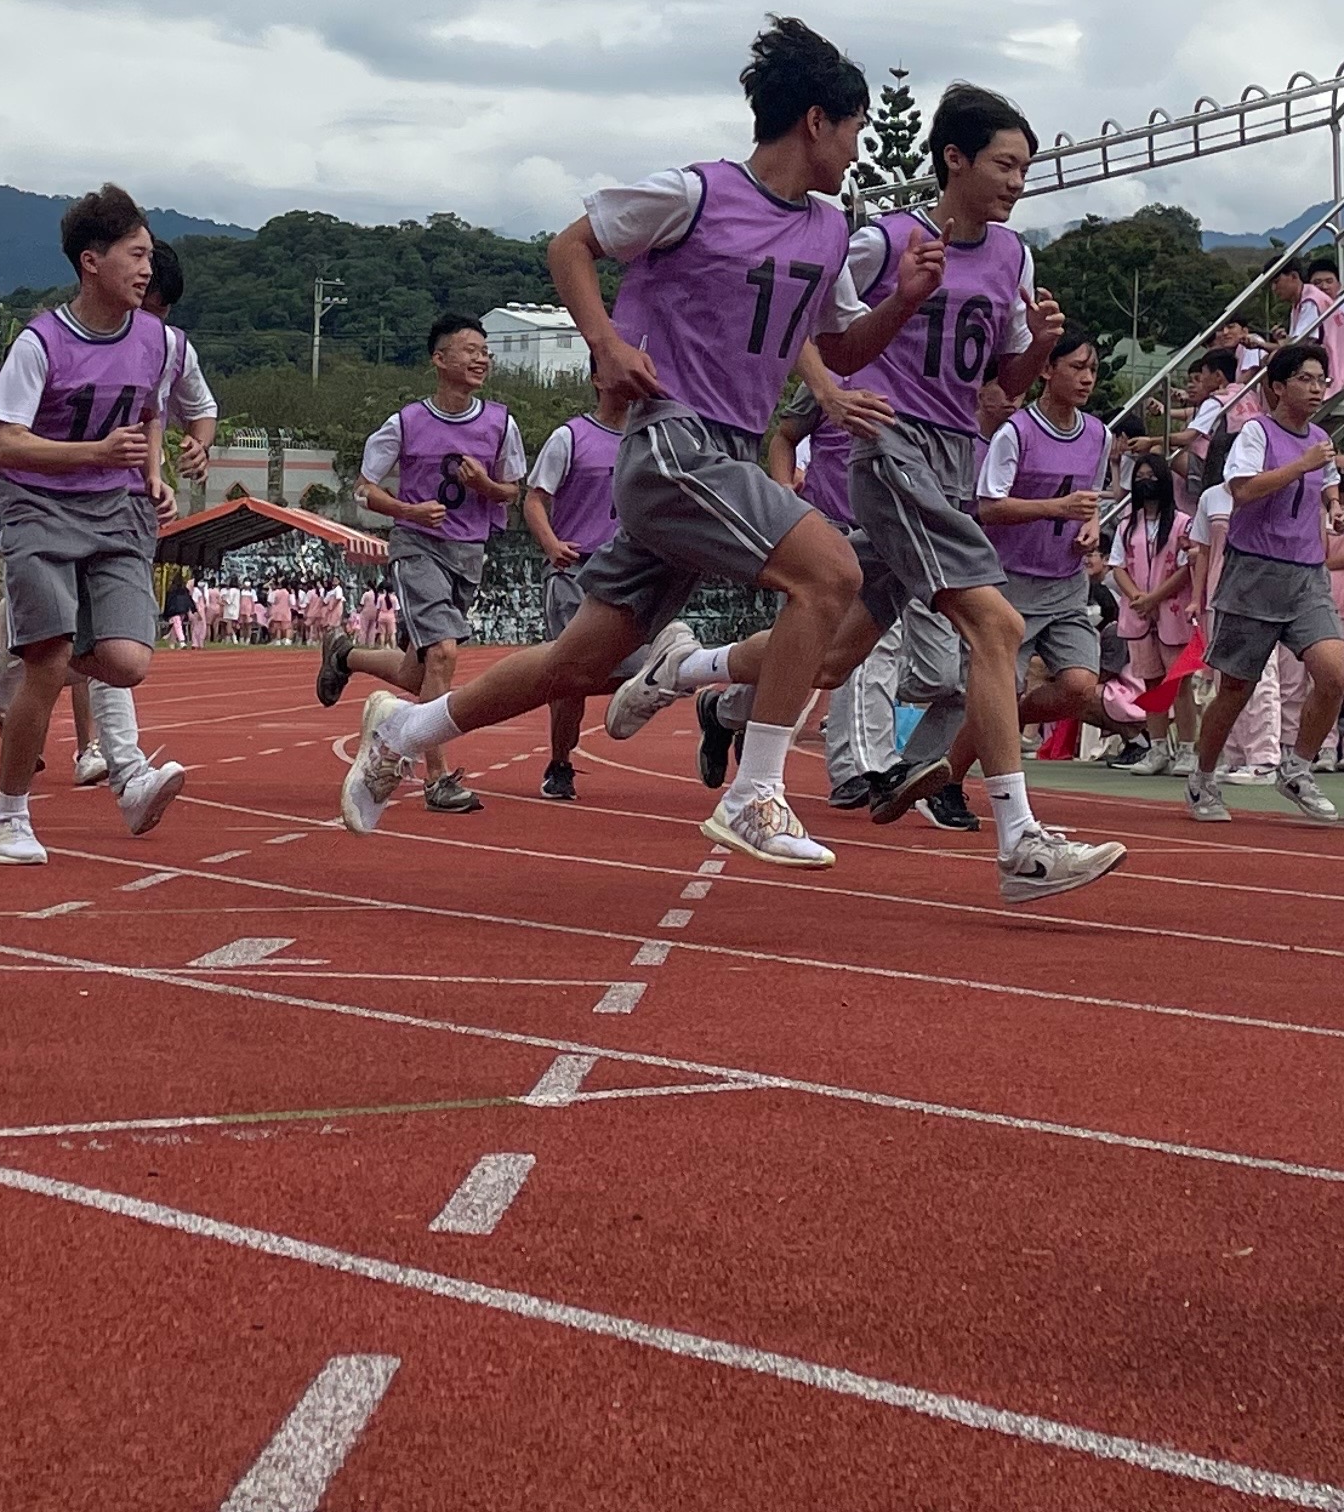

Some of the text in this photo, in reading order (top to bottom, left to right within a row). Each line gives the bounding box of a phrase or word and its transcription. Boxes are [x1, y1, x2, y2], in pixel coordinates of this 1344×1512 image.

[745, 255, 825, 360] 17
[916, 287, 993, 384] 16
[437, 453, 467, 510] 8
